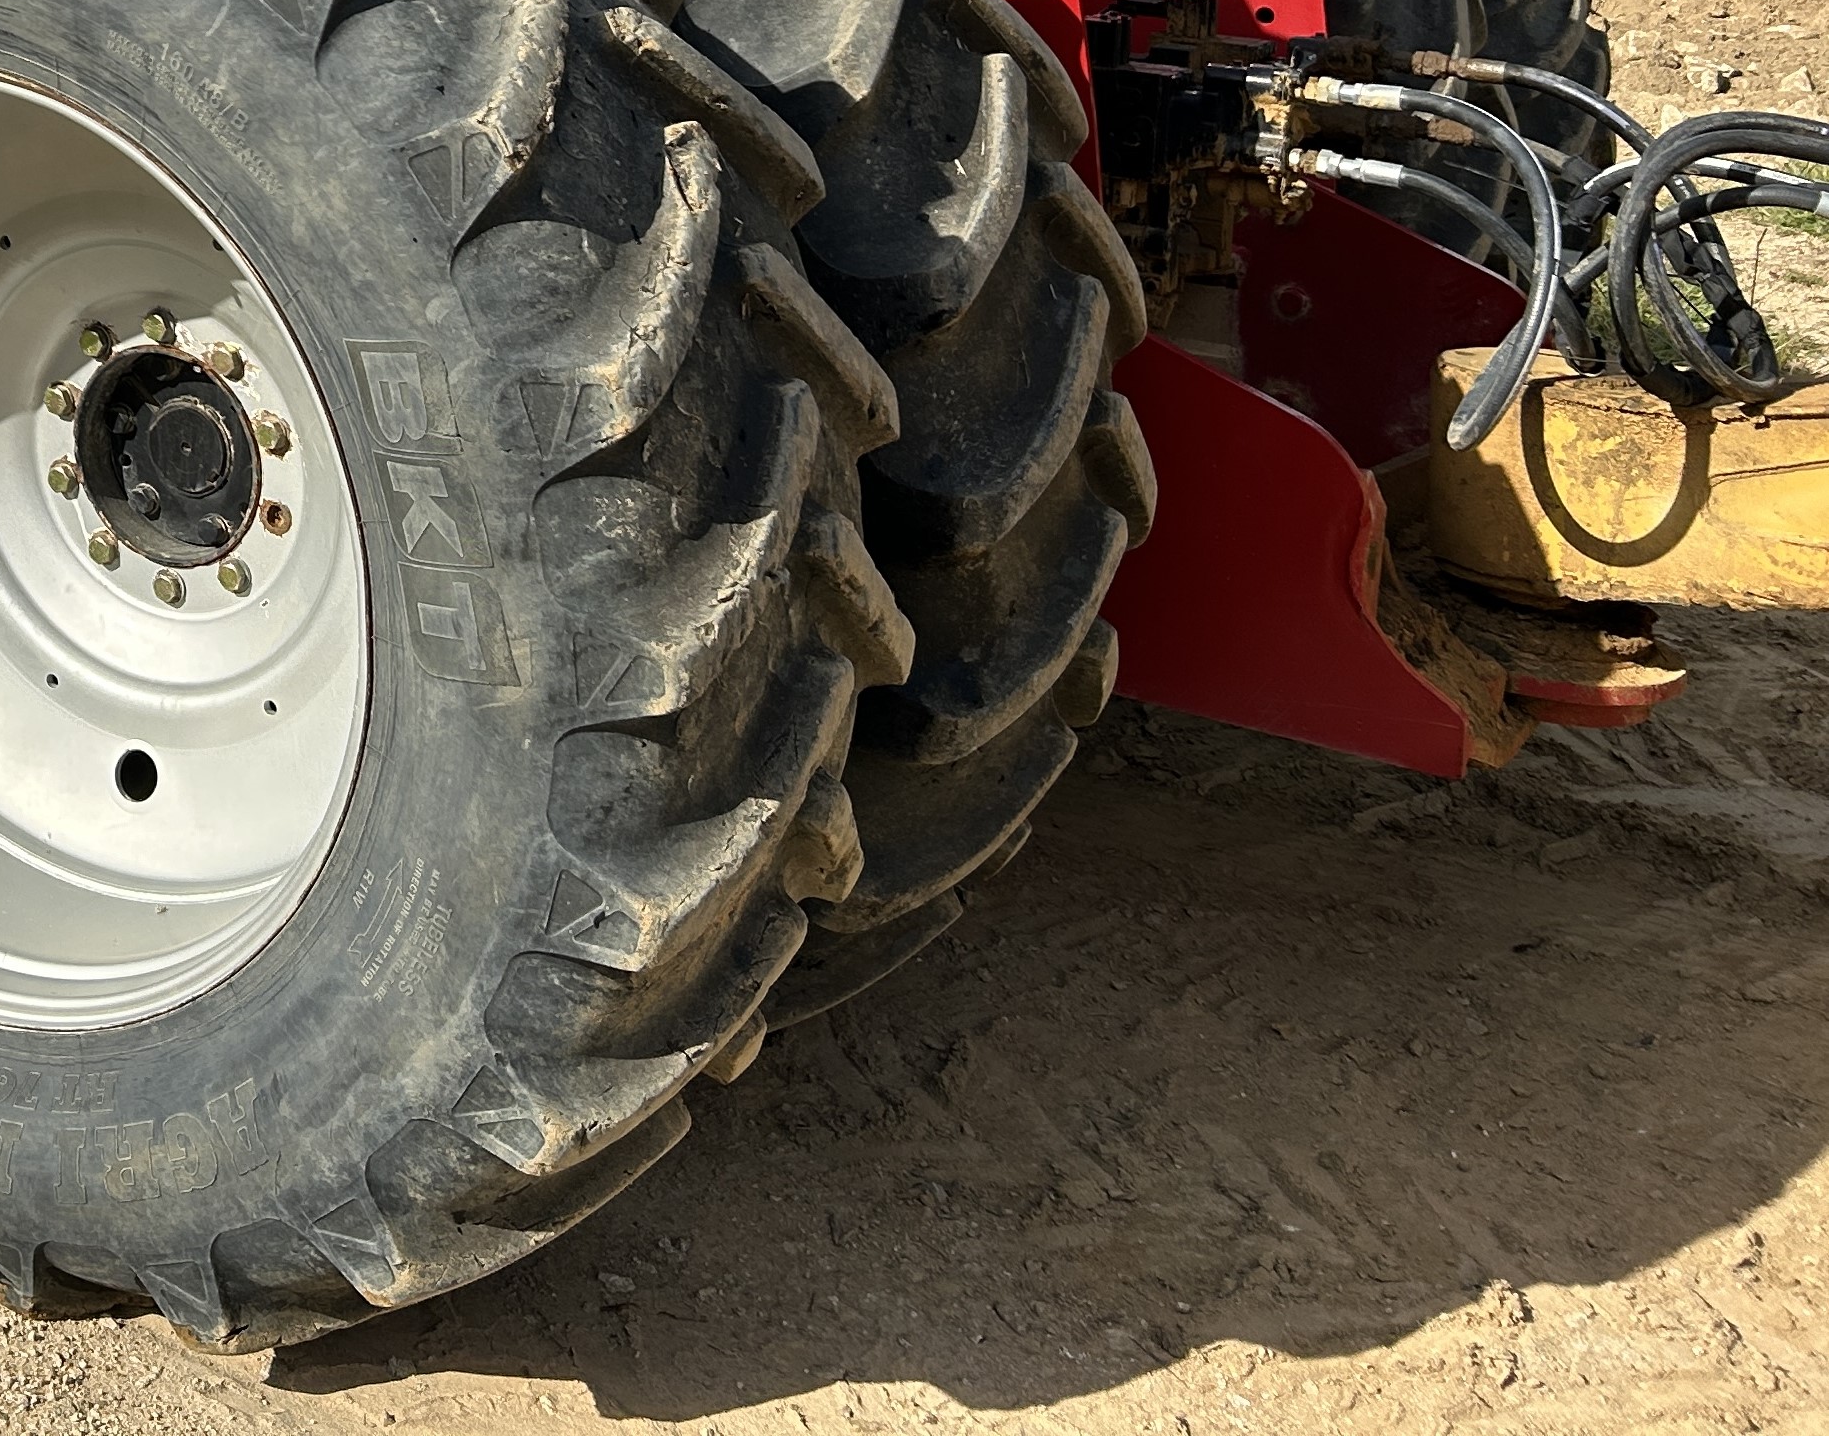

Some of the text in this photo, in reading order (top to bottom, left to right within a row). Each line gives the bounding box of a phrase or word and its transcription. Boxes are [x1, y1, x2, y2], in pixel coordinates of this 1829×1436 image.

[360, 350, 488, 672] BKT
[359, 858, 426, 987] DIRECTION OF ROTATION
[398, 904, 453, 997] TUBELESS
[50, 1071, 119, 1114] RT
[54, 1077, 269, 1205] AGRI
